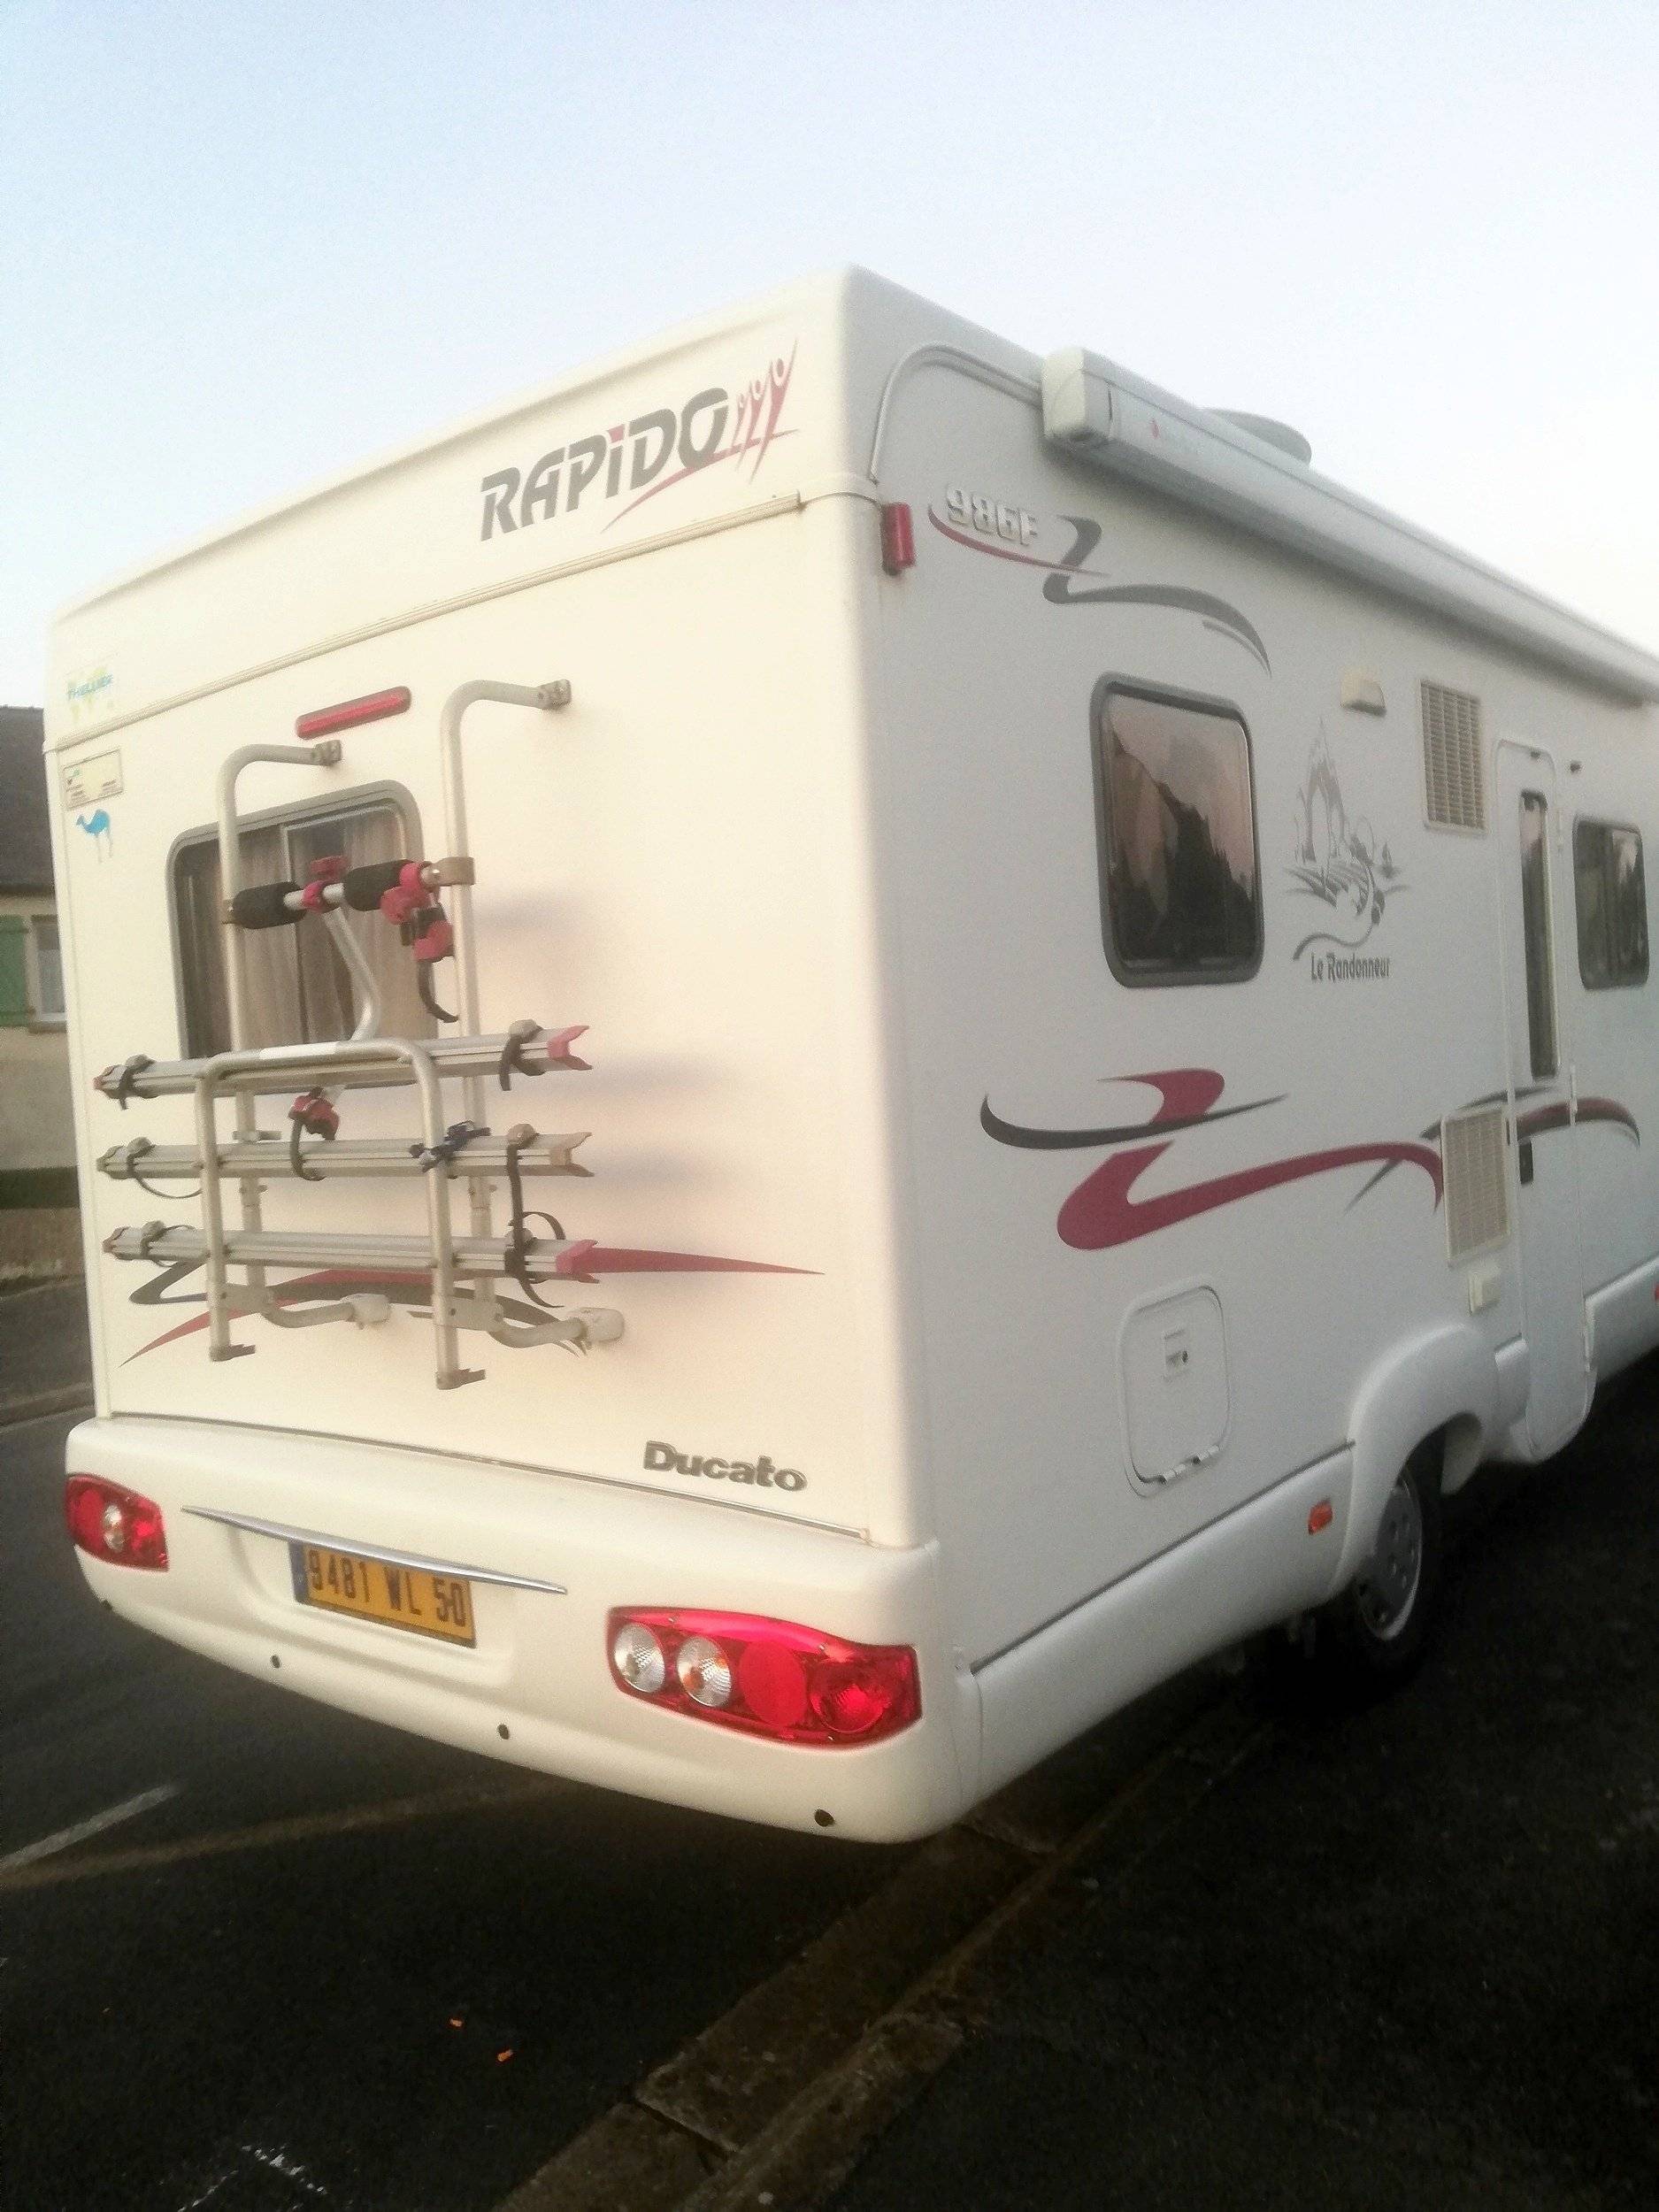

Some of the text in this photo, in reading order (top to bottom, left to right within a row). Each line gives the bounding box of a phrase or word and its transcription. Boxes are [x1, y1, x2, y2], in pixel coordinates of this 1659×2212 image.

[1310, 951, 1390, 982] Le Randonneur
[643, 1440, 809, 1492] Ducato
[384, 1563, 422, 1617] WL
[433, 1576, 466, 1627] 50
